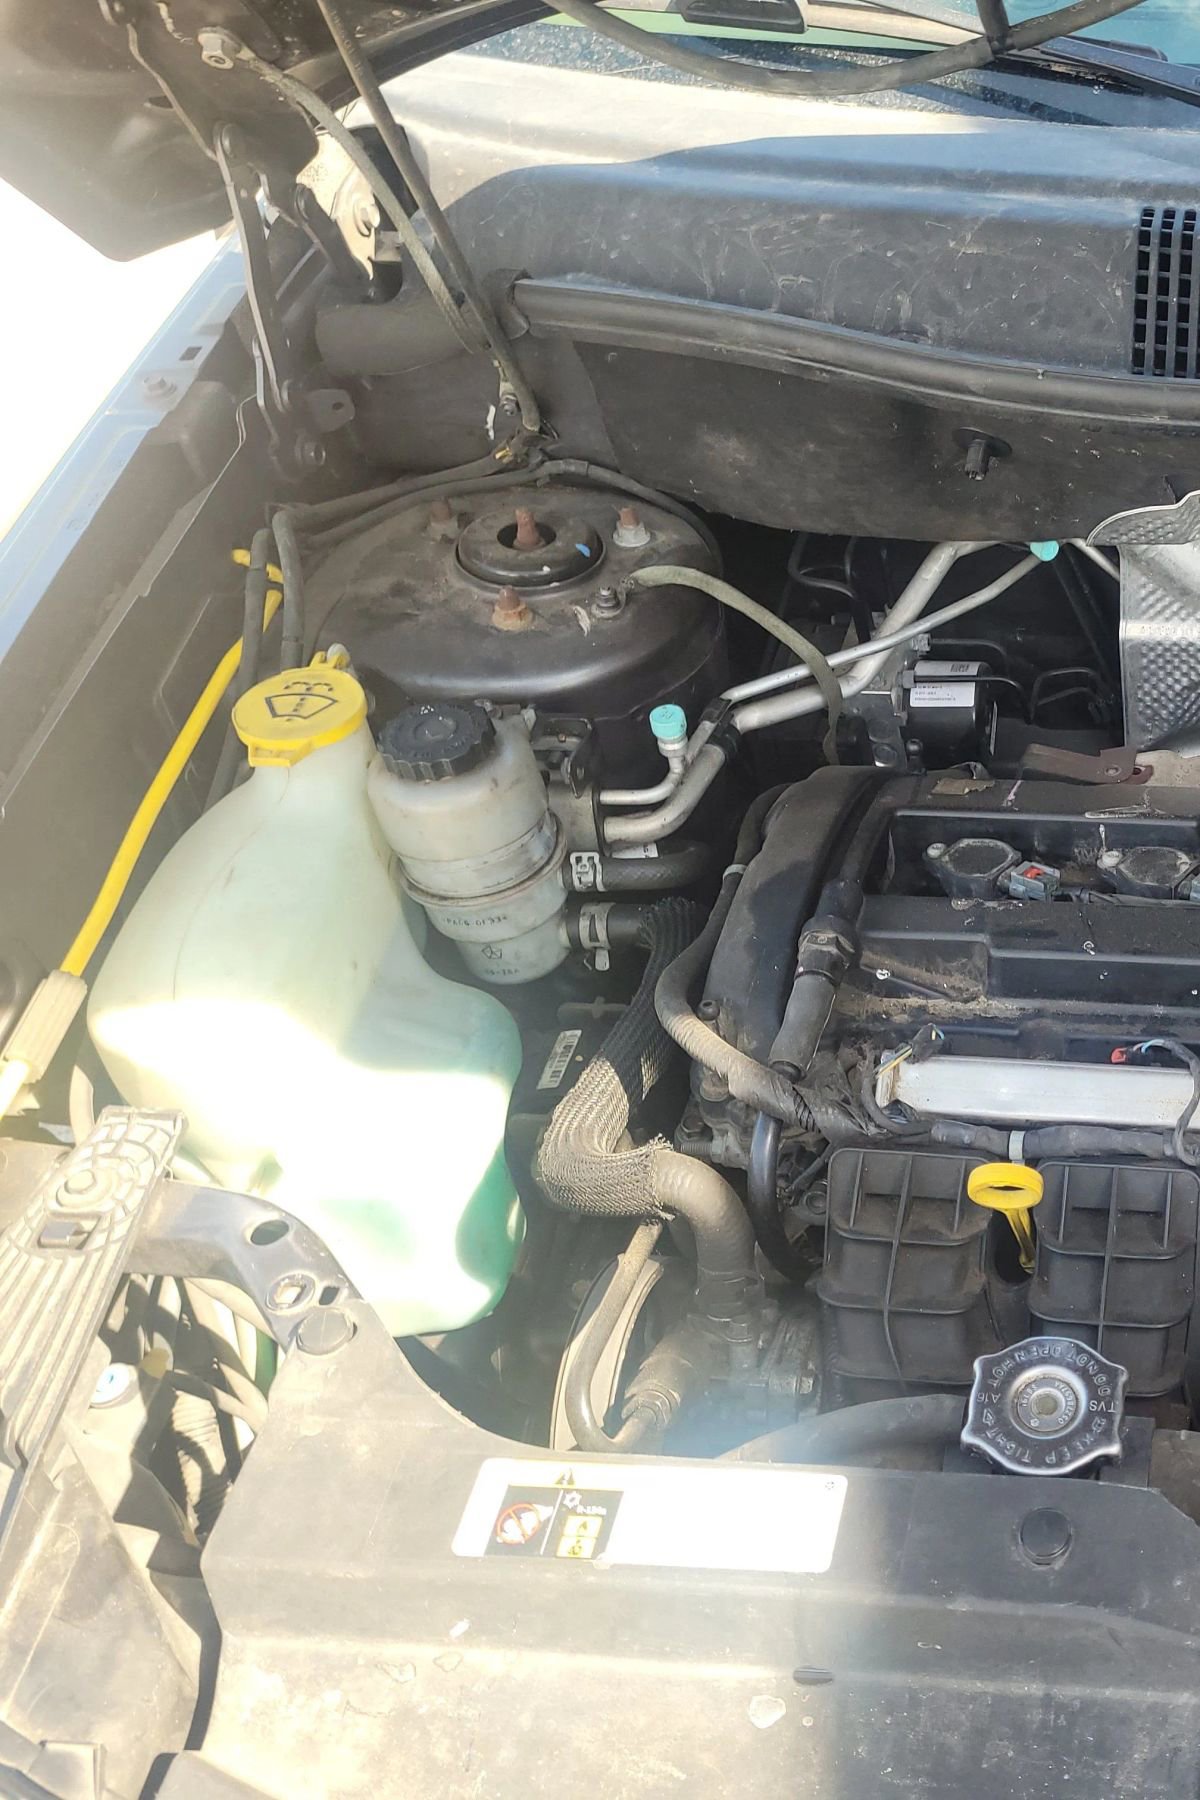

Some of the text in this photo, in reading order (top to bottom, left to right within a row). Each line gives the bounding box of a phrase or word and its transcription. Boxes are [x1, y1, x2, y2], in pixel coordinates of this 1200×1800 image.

[987, 1346, 1112, 1397] DO NOT OPEN HOT
[977, 1391, 1001, 1405] A16
[1089, 1400, 1117, 1413] TVS
[985, 1427, 1095, 1464] KEEP TIGHT
